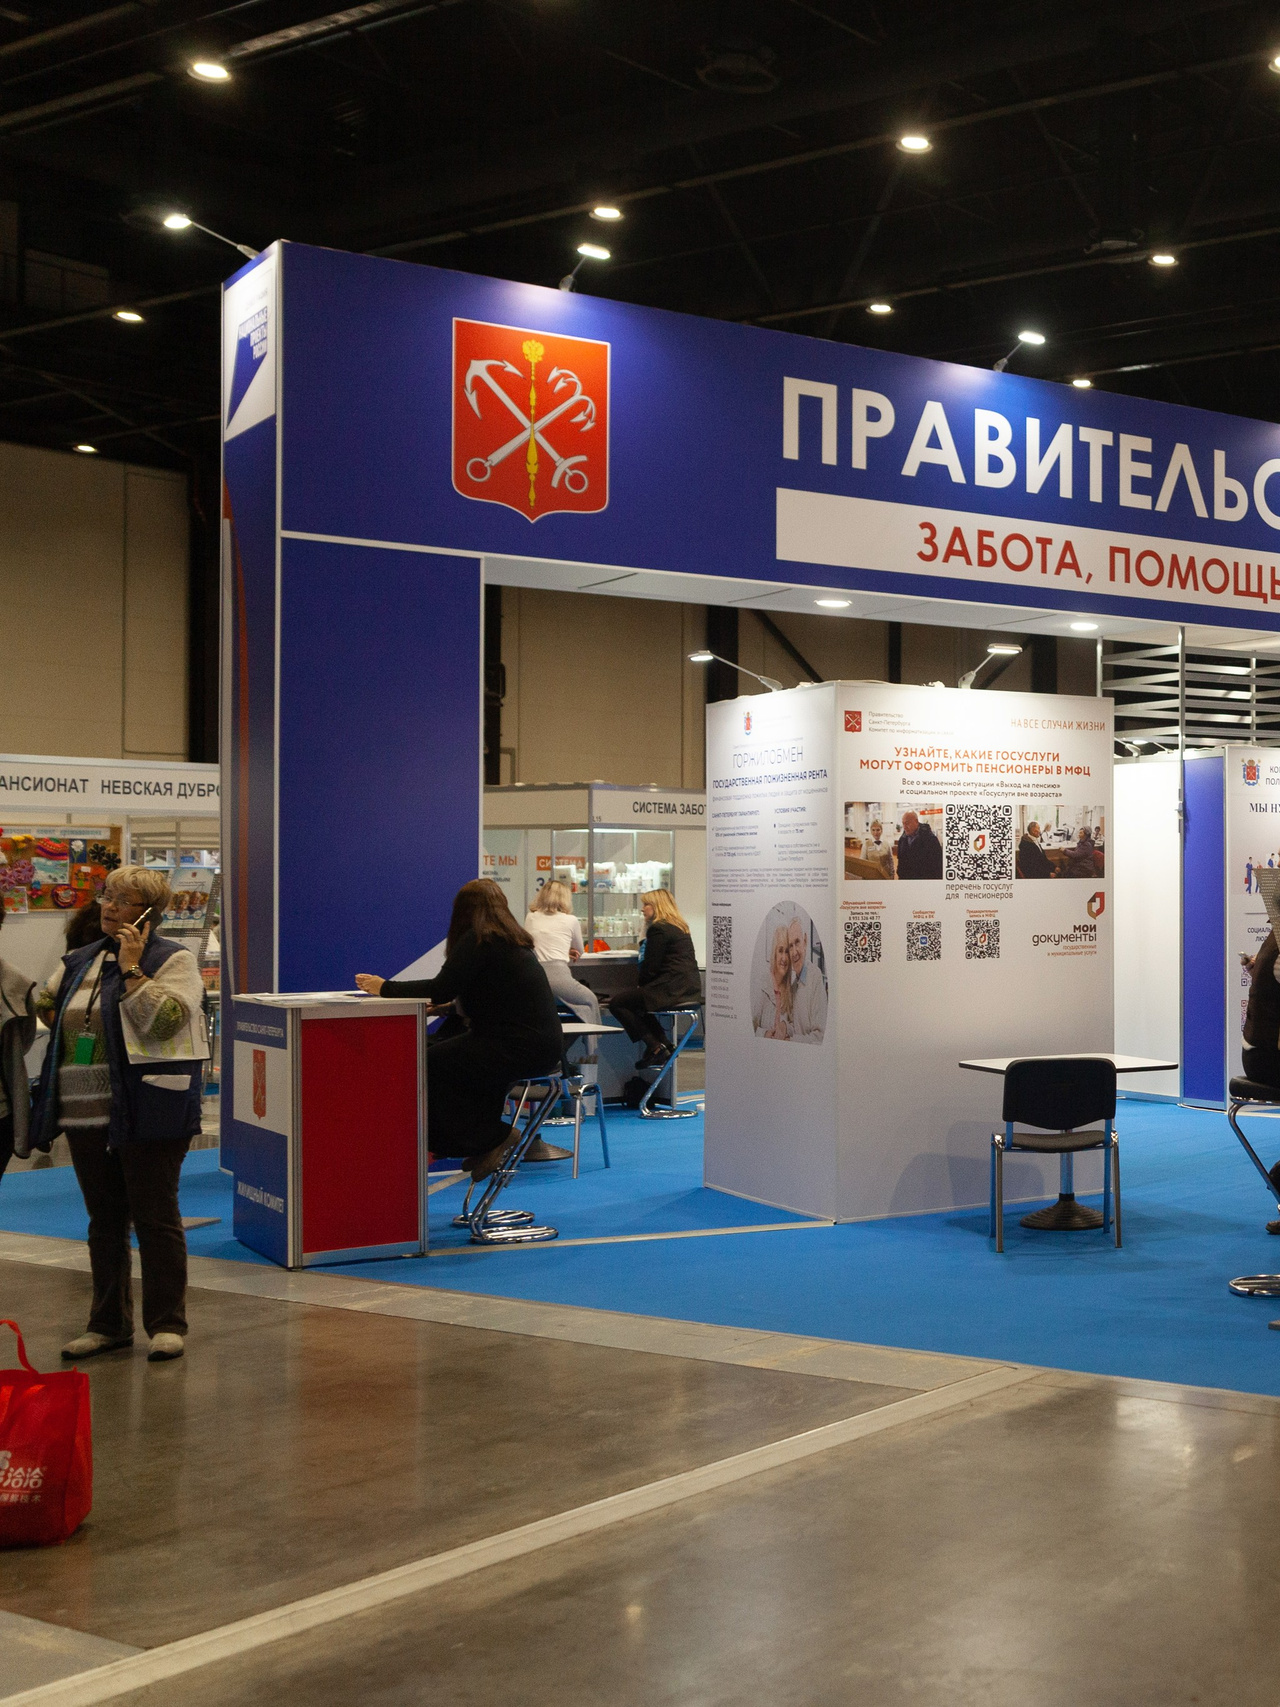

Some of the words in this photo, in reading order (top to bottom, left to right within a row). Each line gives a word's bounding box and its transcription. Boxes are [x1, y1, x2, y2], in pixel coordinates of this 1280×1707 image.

[916, 521, 1094, 584] ЗАБОТА,
[1023, 718, 1039, 729] ВСЕ
[1075, 721, 1106, 731] ЖИЗНИ
[732, 746, 804, 769] ГОРЖИЛОБМЕН
[894, 746, 953, 760] УЗНАЙТЕ,
[954, 749, 993, 760] КАКИЕ
[995, 750, 1060, 762] ГОСУСЛУГИ
[859, 759, 902, 771] МОГУТ
[904, 761, 973, 773] ОФОРМИТЬ
[975, 763, 1054, 775] ПЕНСИОНЕРЫ
[1056, 765, 1062, 775] В
[1064, 765, 1091, 777] МФЦ
[808, 769, 828, 780] РЕНТА
[0, 775, 89, 793] АНСИОНАТ
[101, 779, 173, 796] НЕВСКАЯ
[901, 778, 915, 786] Все
[921, 779, 962, 788] жизненной
[962, 781, 995, 789] ситуации
[906, 788, 948, 796] социальном
[949, 789, 978, 797] проекте
[632, 801, 678, 815] СИСТЕМА
[1249, 802, 1268, 813] МЫ
[498, 854, 518, 866] МЫ
[945, 882, 982, 893] перечень
[982, 882, 1014, 892] госуслуг
[945, 892, 960, 901] для
[964, 892, 1014, 901] пенсионеров
[1073, 924, 1097, 933] мои
[1032, 933, 1097, 947] документы
